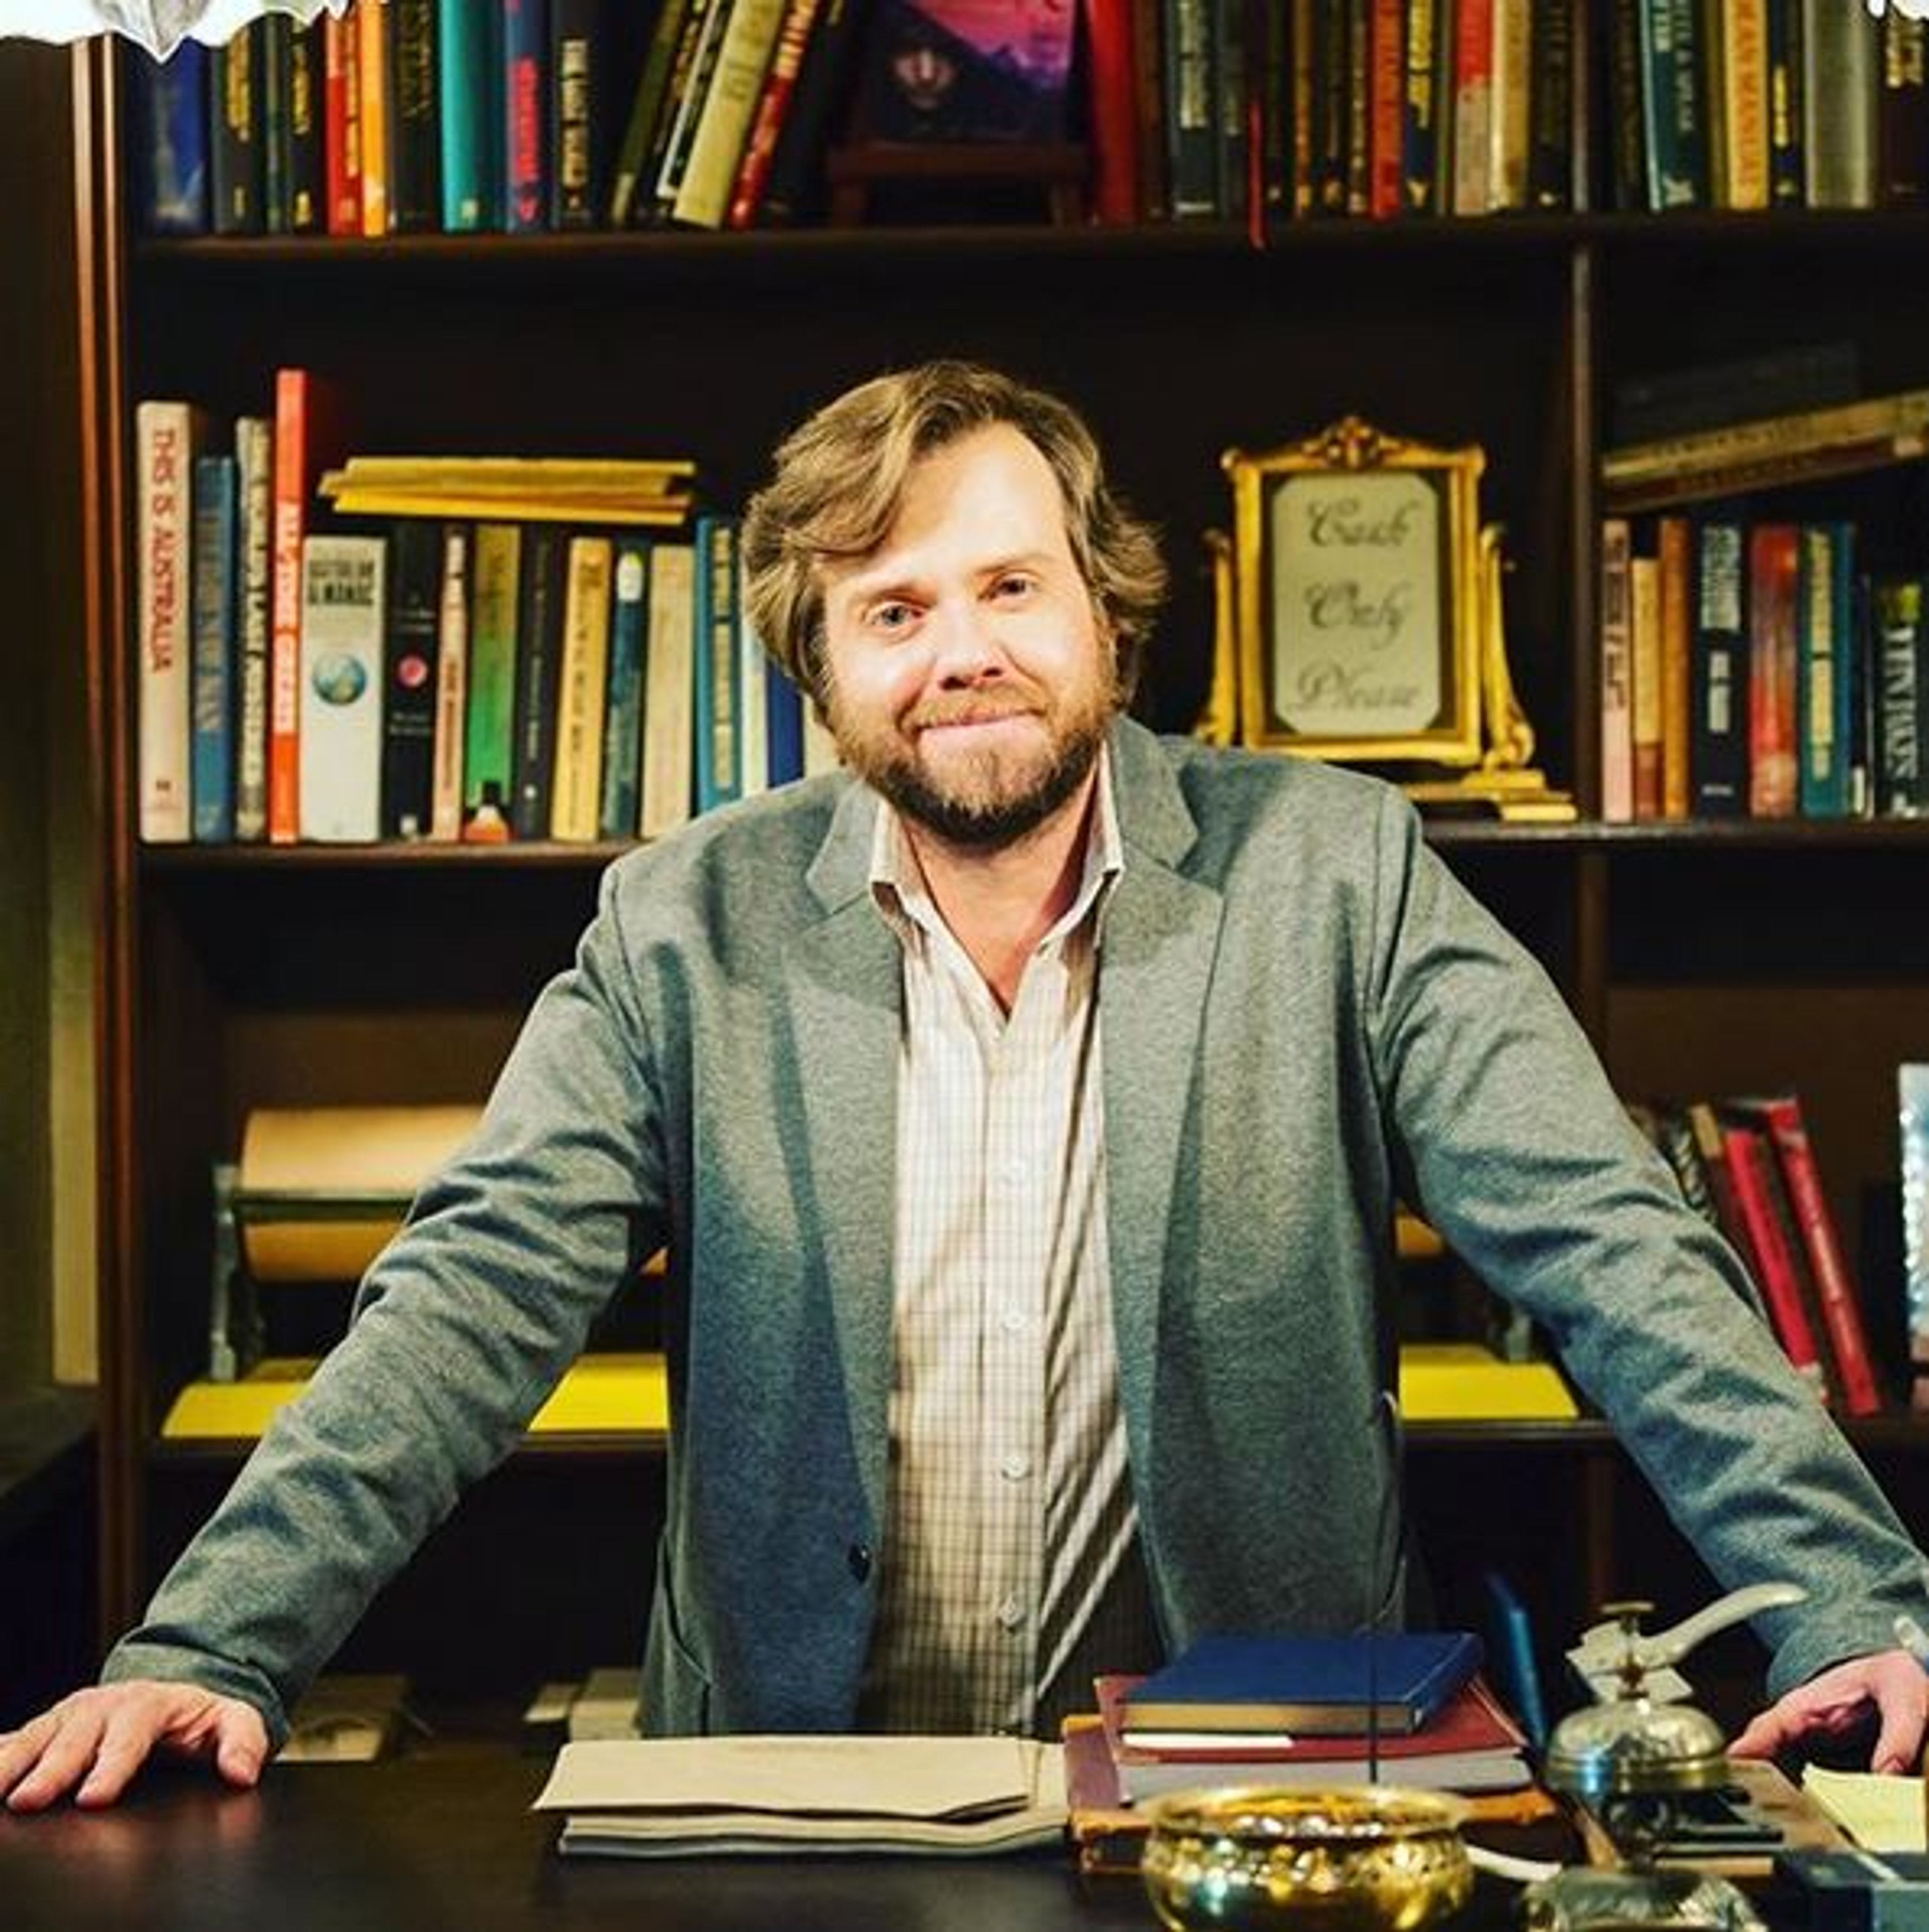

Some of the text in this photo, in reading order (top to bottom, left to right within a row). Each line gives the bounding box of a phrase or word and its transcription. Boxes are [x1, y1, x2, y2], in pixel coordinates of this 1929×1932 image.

[151, 430, 176, 673] THIS IS AUSTRALIA
